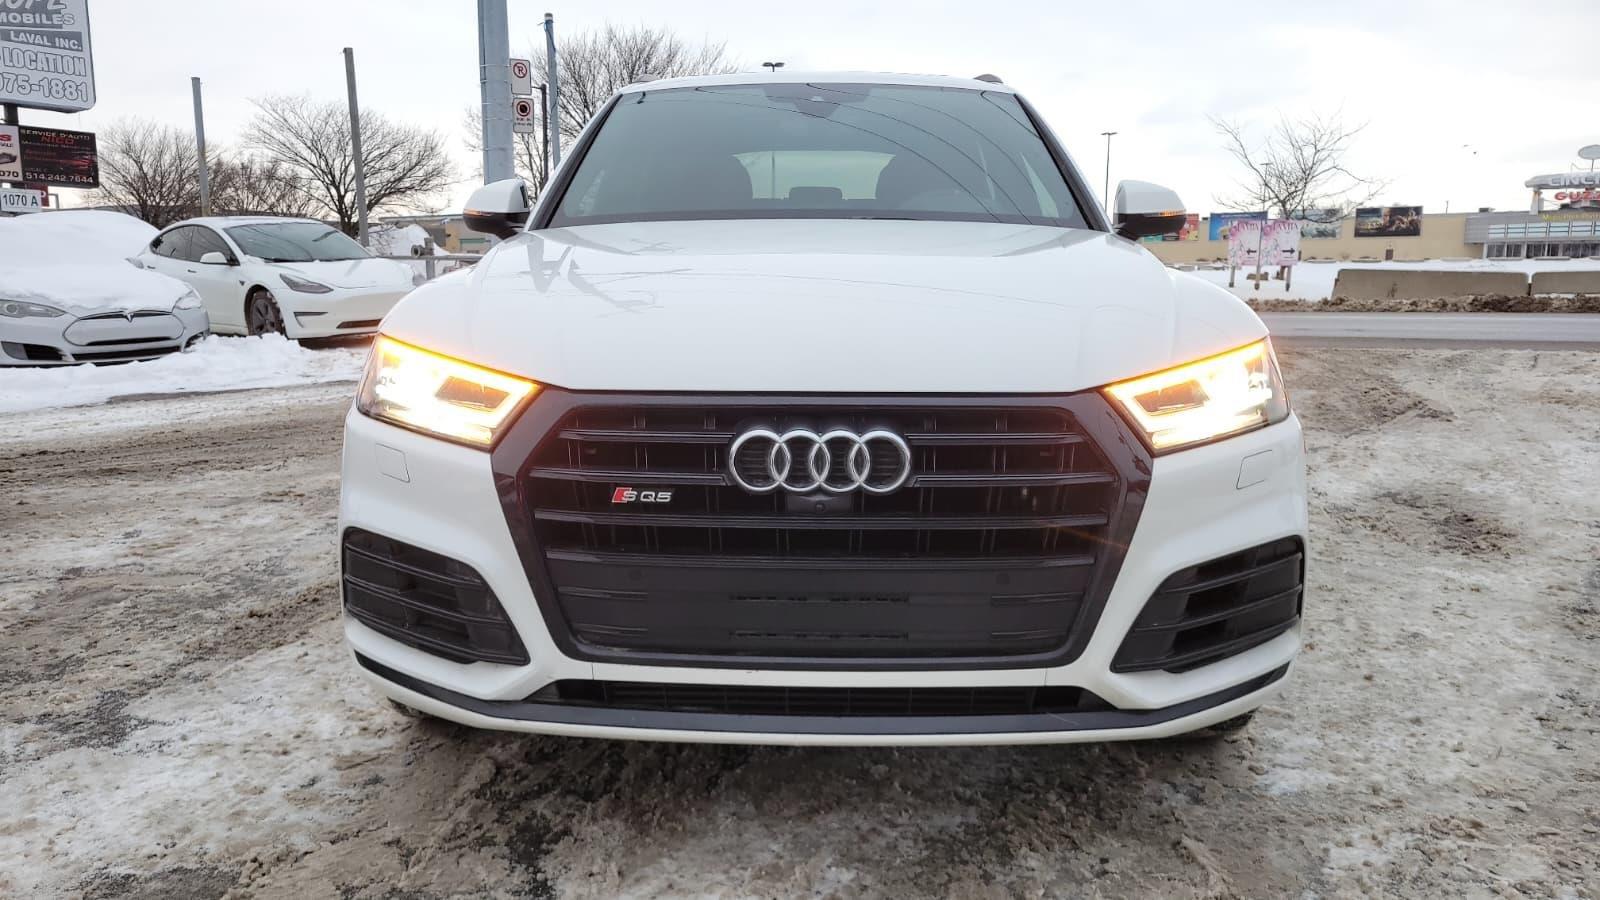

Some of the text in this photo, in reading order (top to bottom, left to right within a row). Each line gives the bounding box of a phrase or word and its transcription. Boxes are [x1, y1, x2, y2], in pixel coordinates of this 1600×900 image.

[10, 31, 82, 50] LAVAL INC.
[2, 47, 87, 77] LOCATION
[0, 72, 89, 102] 75-1881
[3, 194, 39, 206] 1070 A
[621, 490, 672, 503] SQ5
